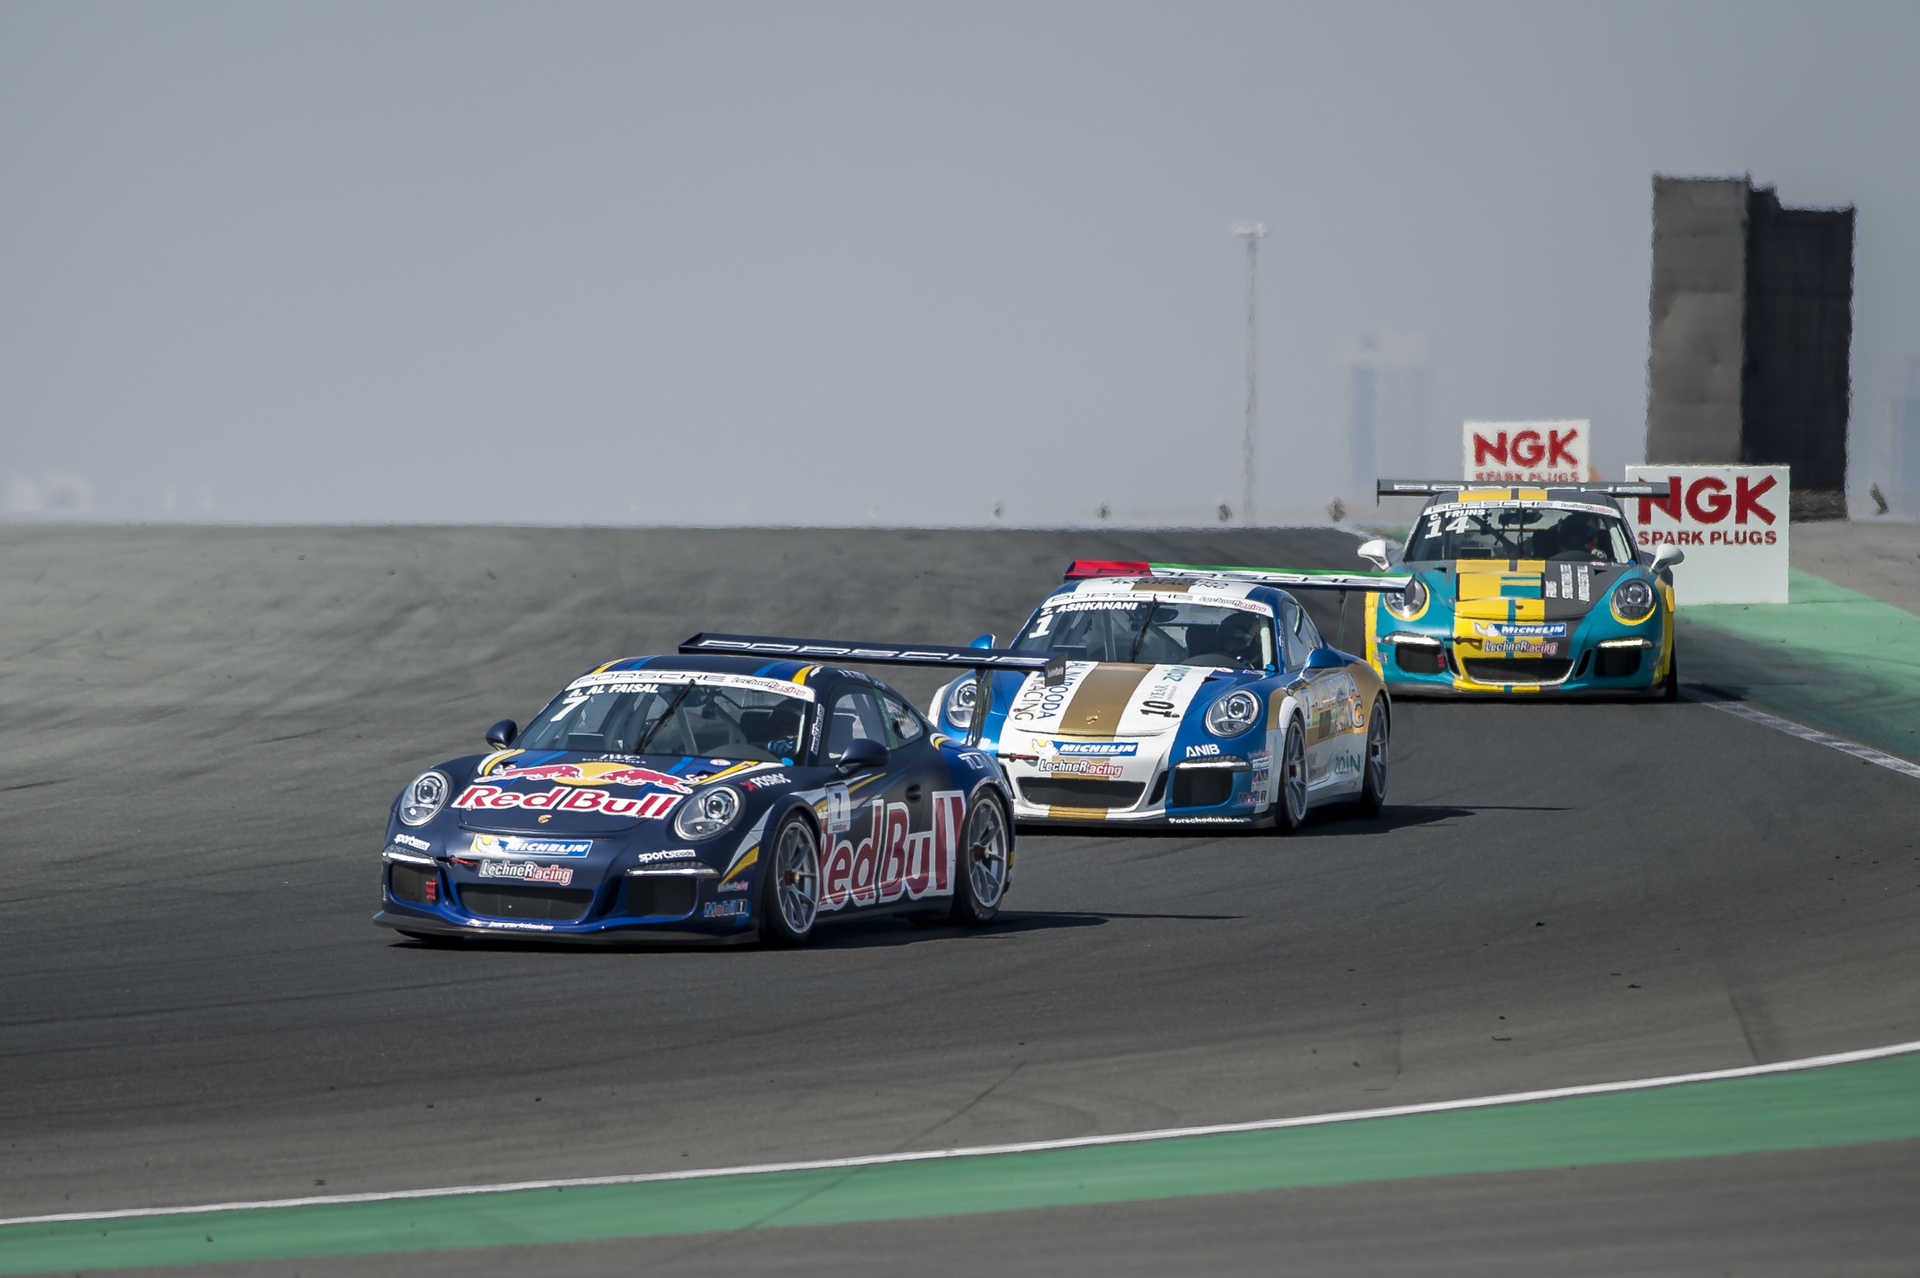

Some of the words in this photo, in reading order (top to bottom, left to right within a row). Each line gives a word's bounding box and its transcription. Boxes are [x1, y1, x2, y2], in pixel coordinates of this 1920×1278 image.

[1473, 428, 1578, 468] NGK
[1637, 474, 1778, 526] NGK
[1424, 516, 1470, 540] 14
[1638, 531, 1705, 546] SPARK
[1709, 530, 1778, 546] PLUGS
[1055, 601, 1139, 614] ASHKANANI
[1028, 614, 1054, 640] 1
[1501, 625, 1565, 635] MICHELIN
[698, 640, 1050, 663] PORSCHE
[1484, 640, 1558, 655] LechneRacing
[586, 684, 605, 696] AL
[608, 683, 660, 694] FAISAL
[550, 695, 590, 722] 7
[1140, 700, 1175, 718] 10
[1058, 743, 1138, 754] MICHELIN
[1186, 743, 1221, 758] ANIB
[1038, 759, 1124, 778] LechneRacing
[452, 785, 568, 812] Red
[557, 789, 684, 820] Bull
[506, 839, 591, 853] MICHELIN
[479, 859, 573, 885] LechneRacing
[704, 900, 737, 917] Mobil
